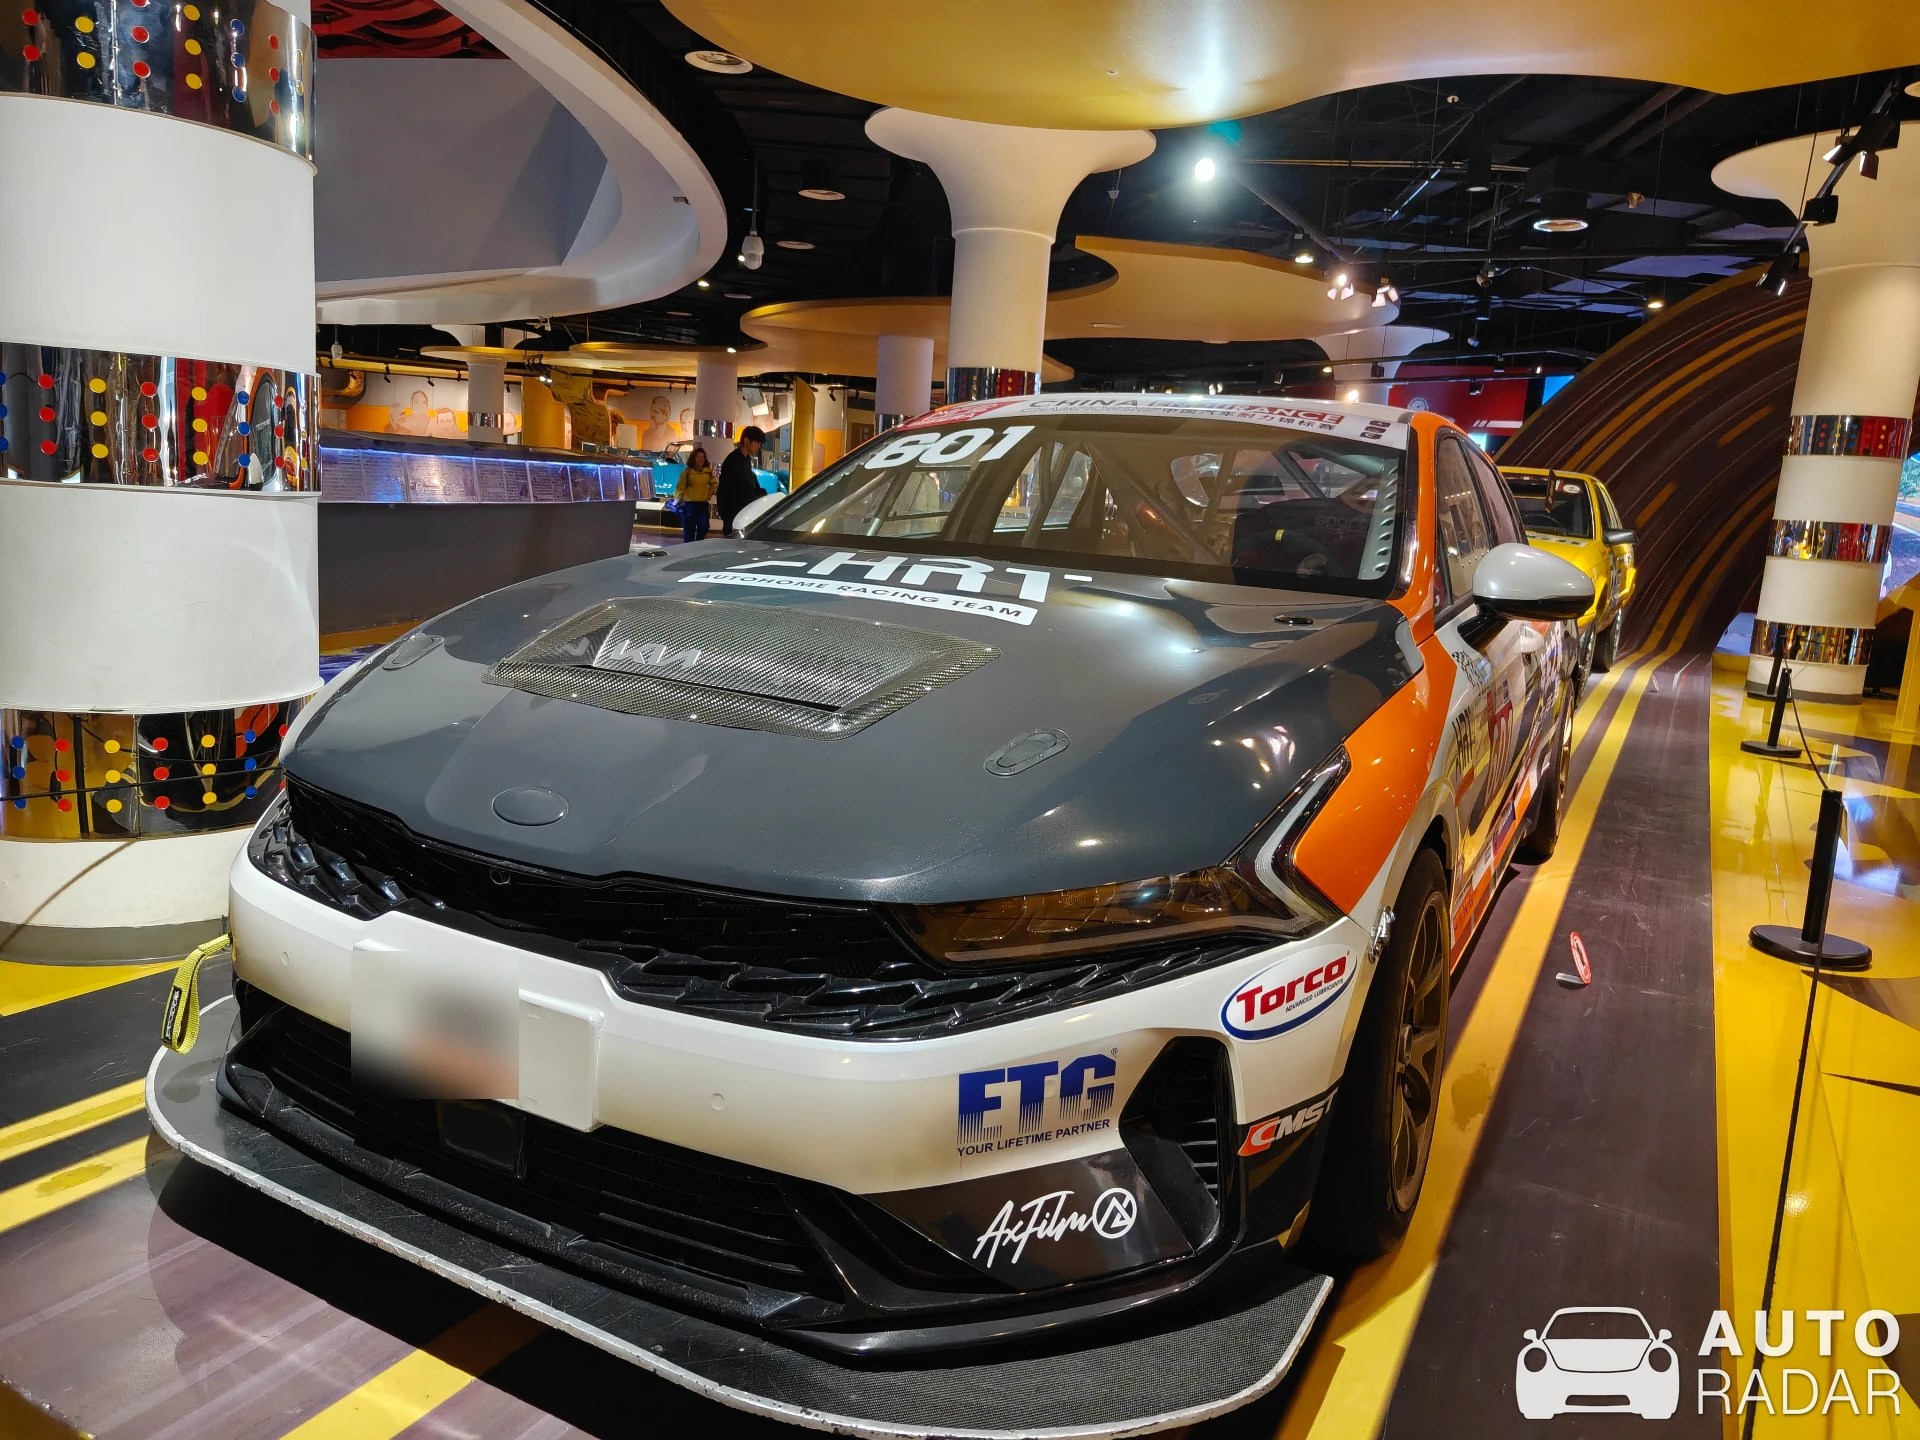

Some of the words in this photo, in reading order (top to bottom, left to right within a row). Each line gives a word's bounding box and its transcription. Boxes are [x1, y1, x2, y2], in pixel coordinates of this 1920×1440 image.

[1029, 399, 1138, 407] CHINA
[864, 425, 1036, 470] 601
[698, 573, 829, 591] AUTOHOME
[838, 586, 939, 603] RACING
[950, 599, 1023, 618] TEAM
[1236, 956, 1347, 1023] Torco
[1285, 994, 1313, 1013] ADVANCED
[1314, 978, 1344, 998] LUBRICANTS
[957, 1143, 993, 1157] YOUR
[997, 1131, 1052, 1150] LIFETIME
[1056, 1119, 1110, 1139] PARTNER
